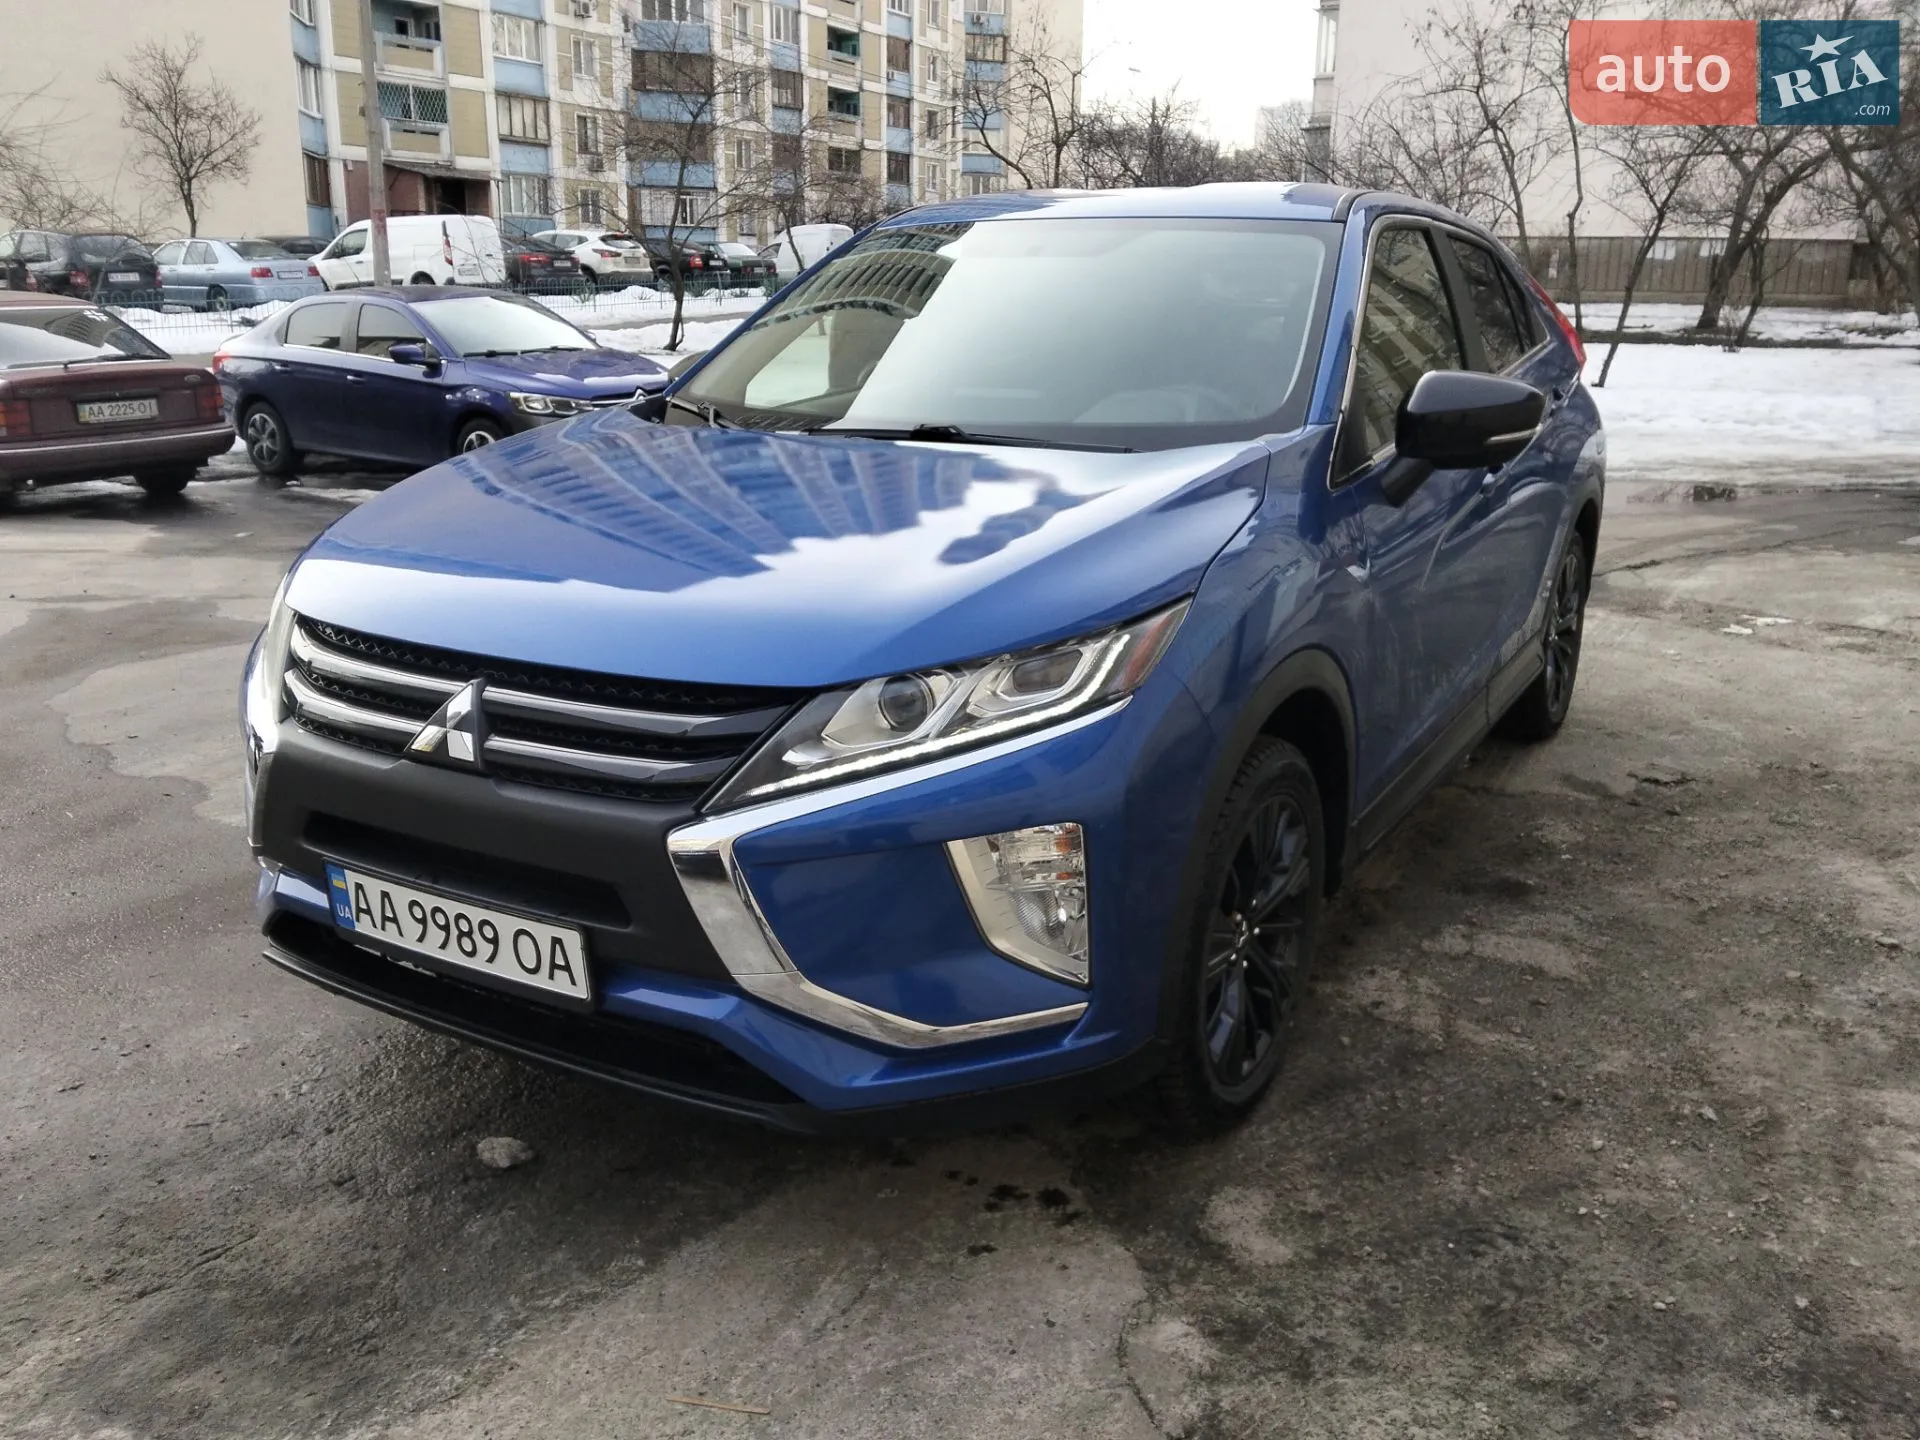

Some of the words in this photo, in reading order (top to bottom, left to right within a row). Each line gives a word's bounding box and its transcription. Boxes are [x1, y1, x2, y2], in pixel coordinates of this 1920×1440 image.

[88, 405, 105, 418] AA
[108, 403, 135, 417] 2225
[337, 903, 352, 920] UA
[354, 881, 404, 938] AA
[408, 898, 500, 964] 9989
[513, 928, 577, 986] OA
